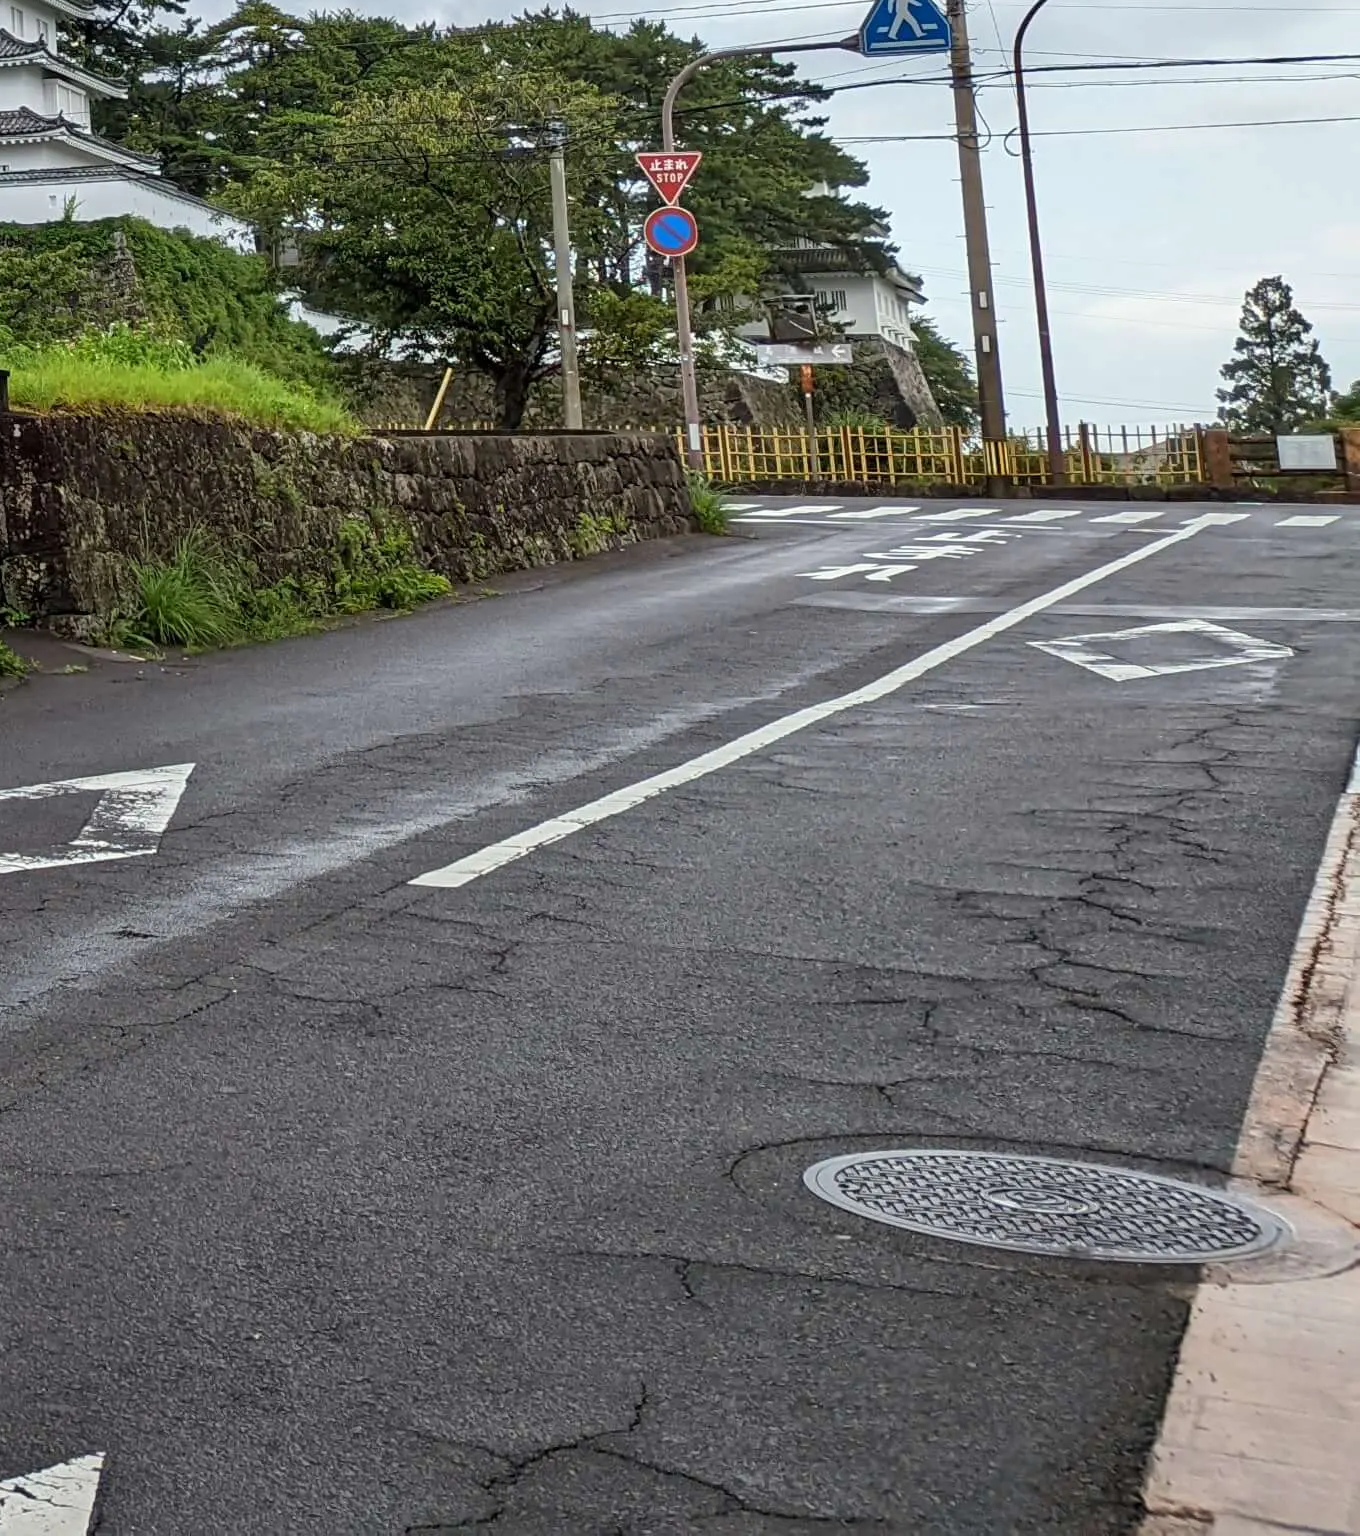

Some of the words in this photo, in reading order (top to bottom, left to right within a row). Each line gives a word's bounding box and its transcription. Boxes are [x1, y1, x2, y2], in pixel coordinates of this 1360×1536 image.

[649, 158, 689, 171] 止まれ
[656, 172, 684, 183] STOP
[794, 530, 1023, 583] 止まれ
